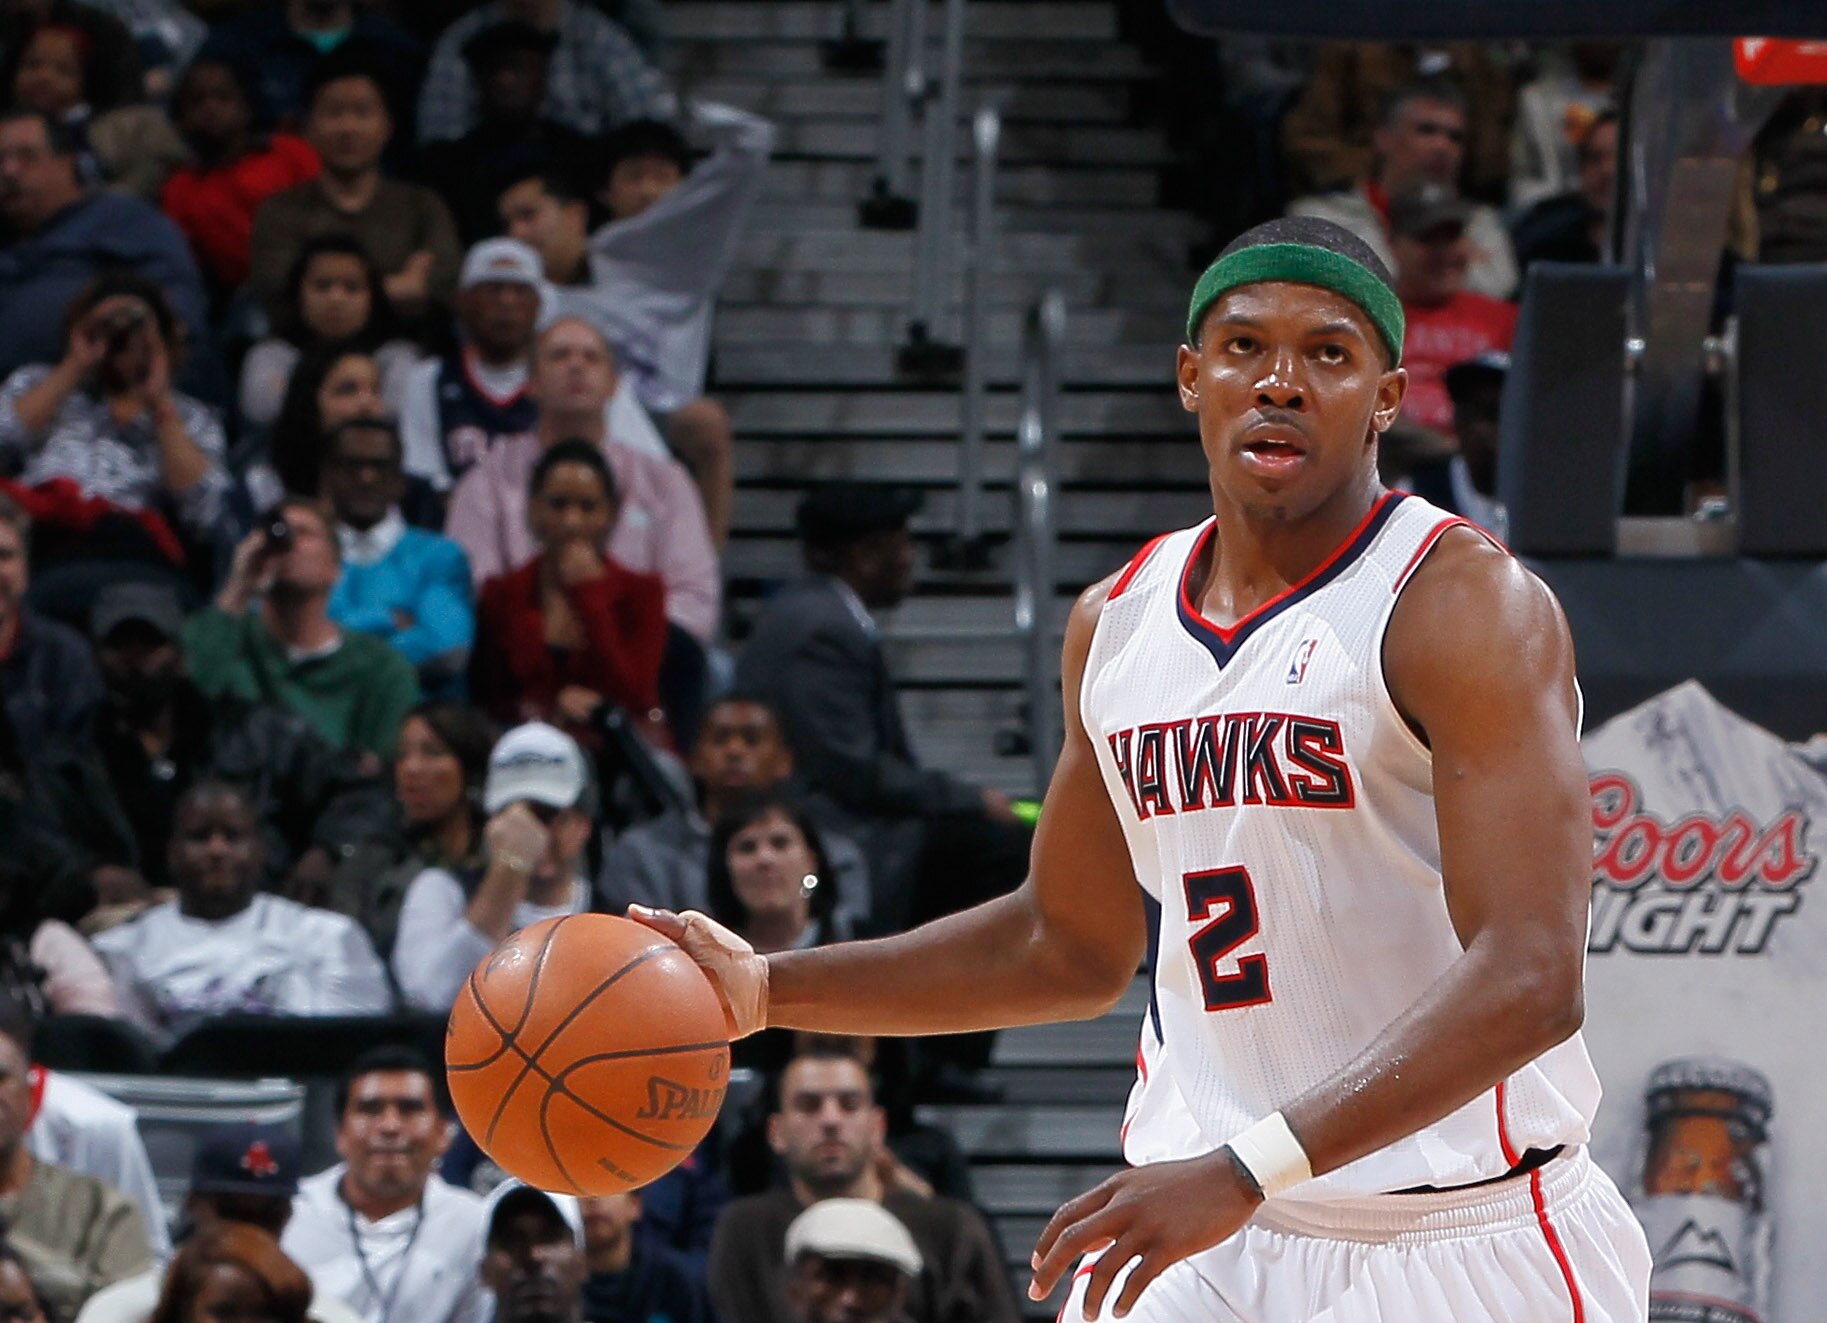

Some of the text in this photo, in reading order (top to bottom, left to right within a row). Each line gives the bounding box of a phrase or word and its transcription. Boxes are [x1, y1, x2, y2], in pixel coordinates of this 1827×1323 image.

[1108, 712, 1356, 821] HAWKS
[1183, 865, 1273, 1012] 2
[1588, 892, 1803, 954] IGHT
